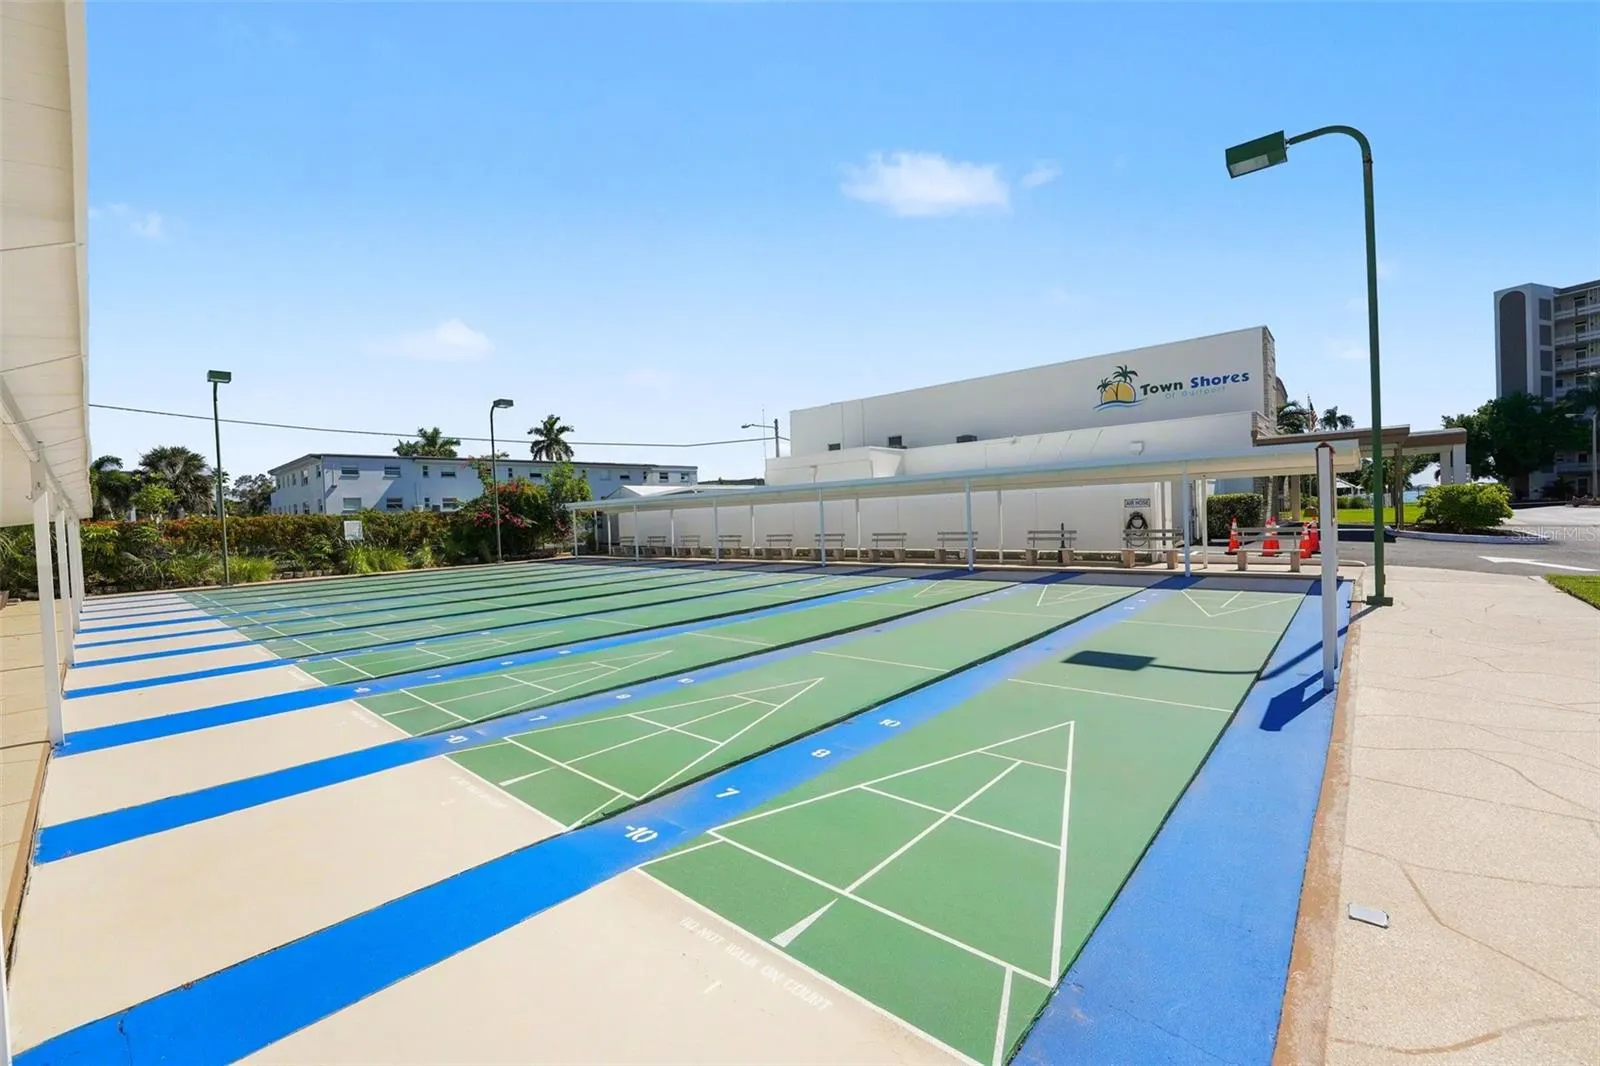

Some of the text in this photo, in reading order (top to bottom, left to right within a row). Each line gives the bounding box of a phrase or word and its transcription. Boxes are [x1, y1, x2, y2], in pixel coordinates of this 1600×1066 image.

[1140, 372, 1250, 396] Town Shores
[811, 748, 831, 758] 8
[716, 787, 740, 798] 7
[624, 825, 658, 843] -10
[696, 928, 725, 944] NOT
[760, 964, 785, 984] ON
[783, 978, 833, 1012] COURT
